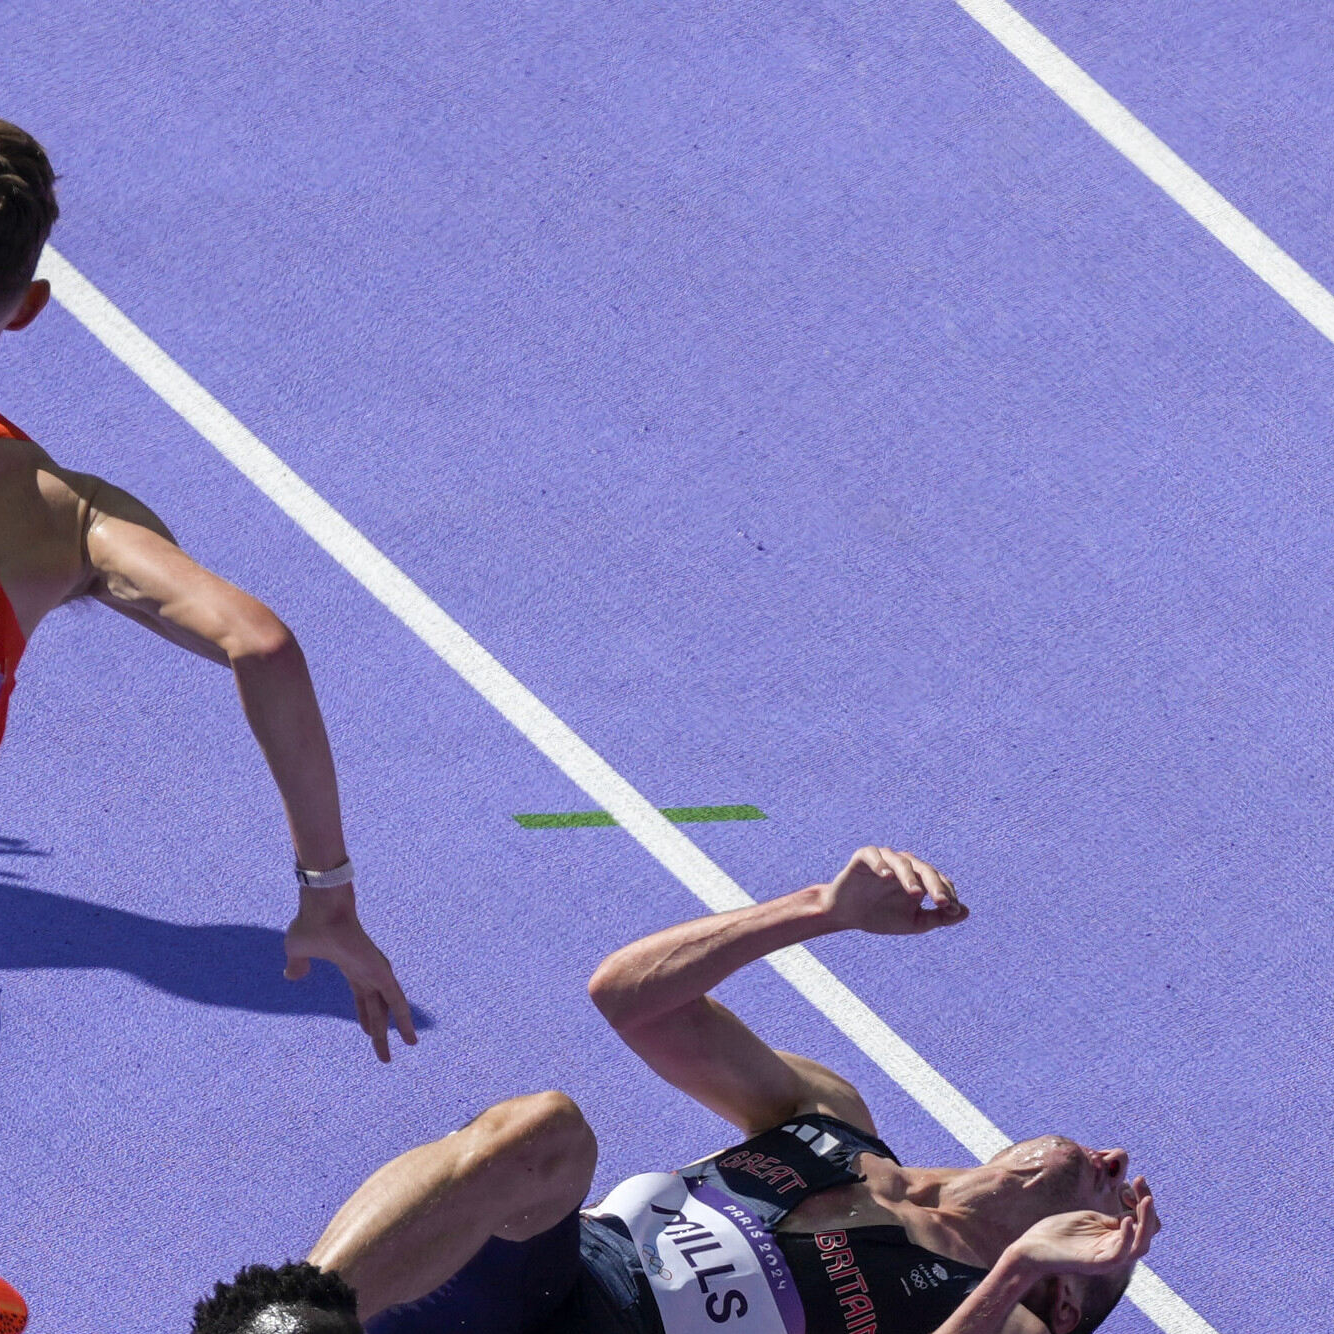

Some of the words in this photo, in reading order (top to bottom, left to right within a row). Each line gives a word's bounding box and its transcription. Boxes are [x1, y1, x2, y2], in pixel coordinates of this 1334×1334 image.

[719, 1149, 809, 1196] GREAT
[651, 1203, 749, 1324] MILLS
[723, 1204, 763, 1239] PARIS
[758, 1243, 787, 1290] 2024
